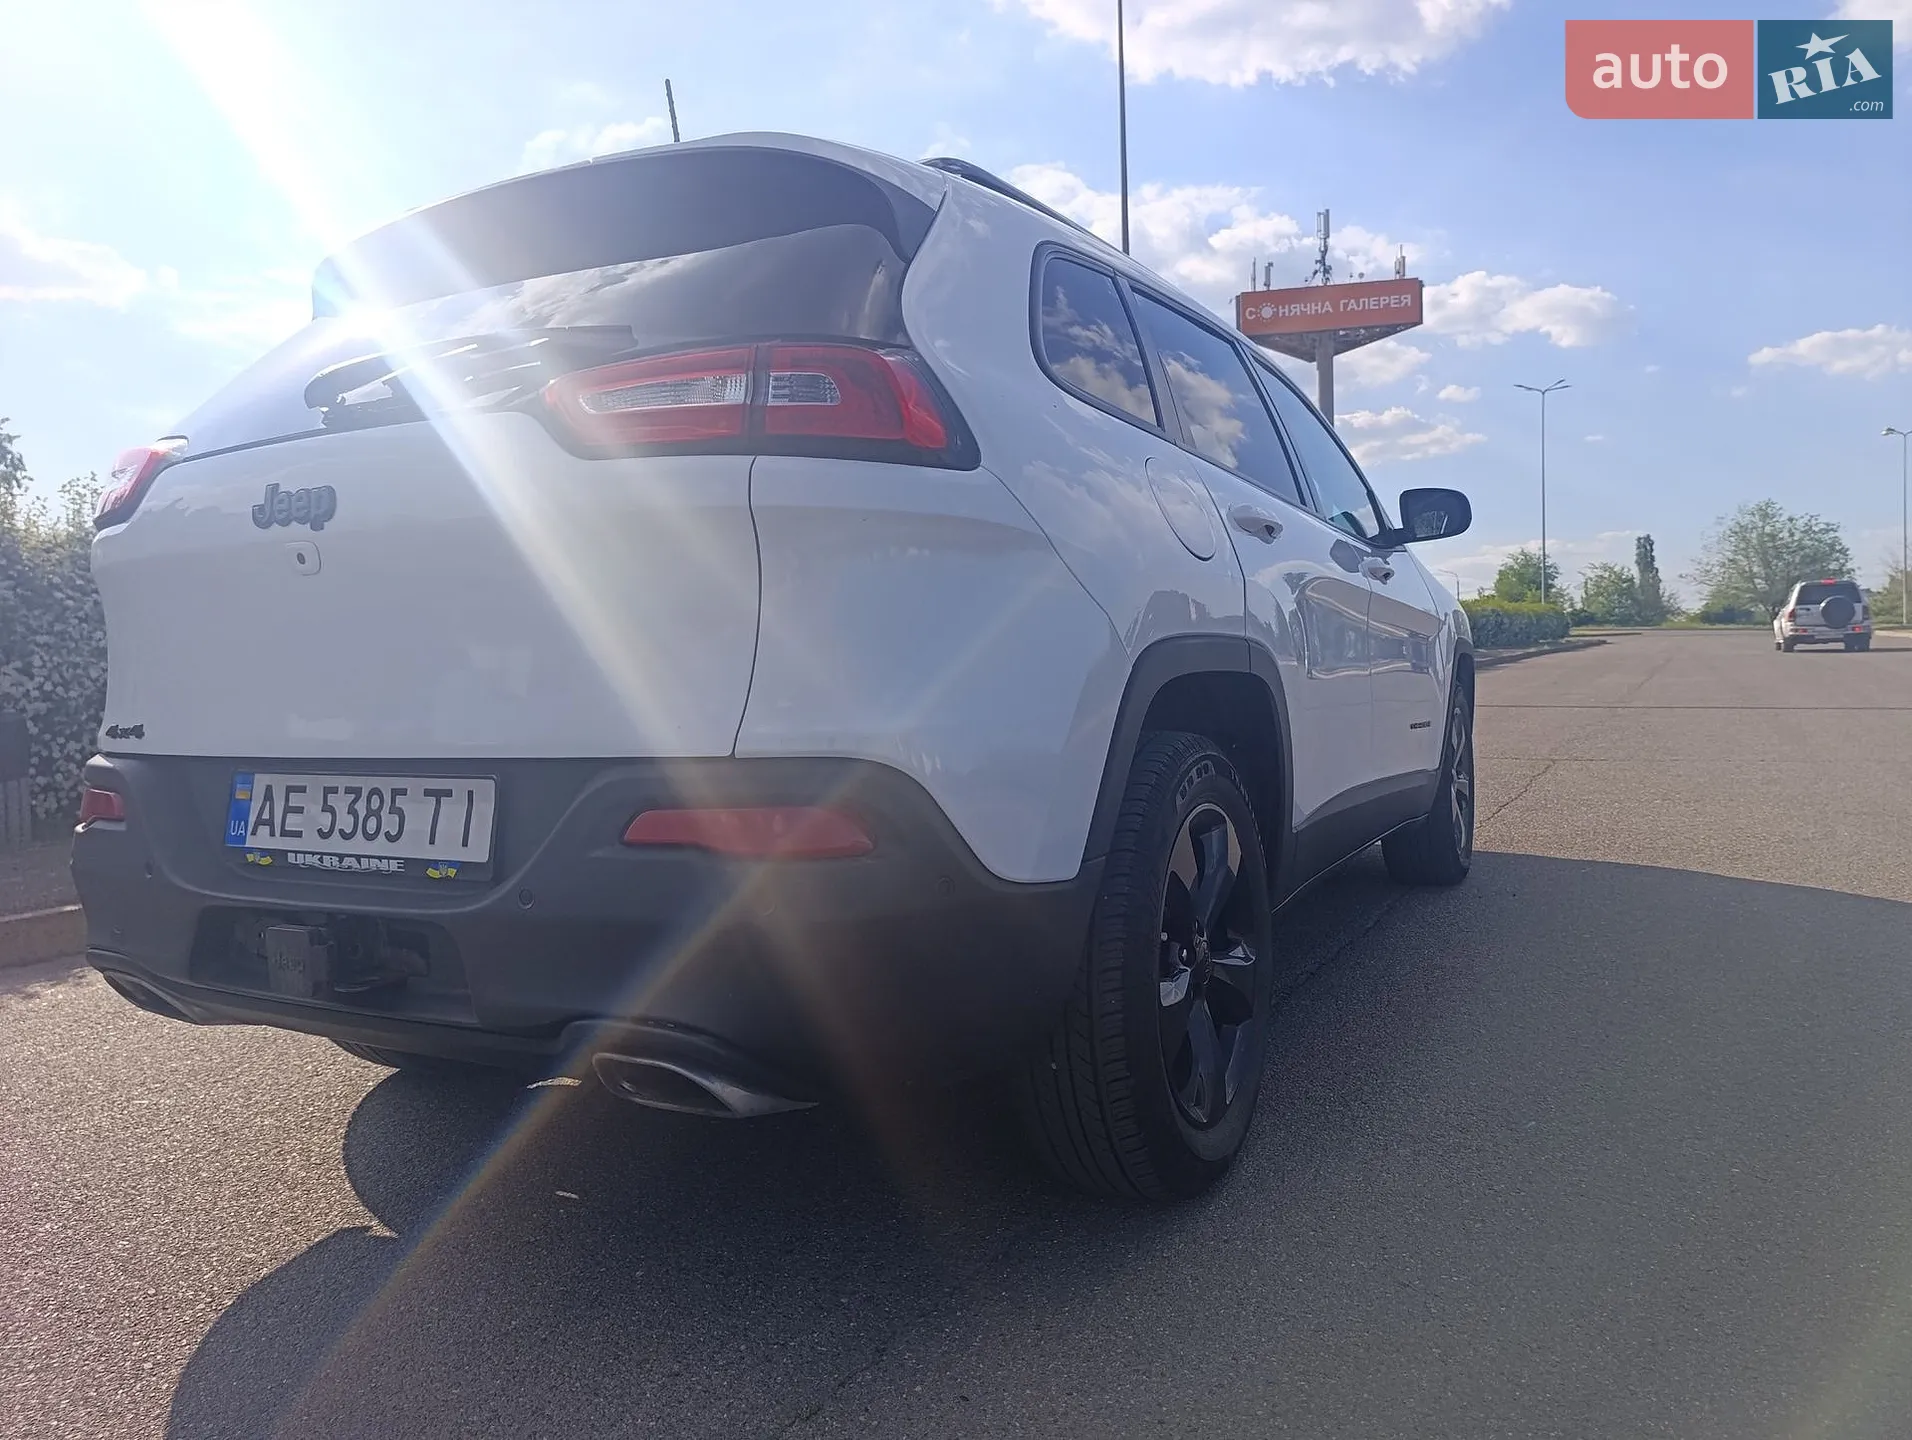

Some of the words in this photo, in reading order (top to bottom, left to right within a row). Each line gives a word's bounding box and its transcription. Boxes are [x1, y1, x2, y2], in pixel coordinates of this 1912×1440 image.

[1339, 294, 1412, 312] ГАЛЕРЕЯ
[252, 483, 337, 531] Jeep
[251, 784, 307, 838] AE
[316, 786, 408, 843] 5385
[230, 820, 246, 836] UA
[287, 852, 405, 874] UKRAINE
